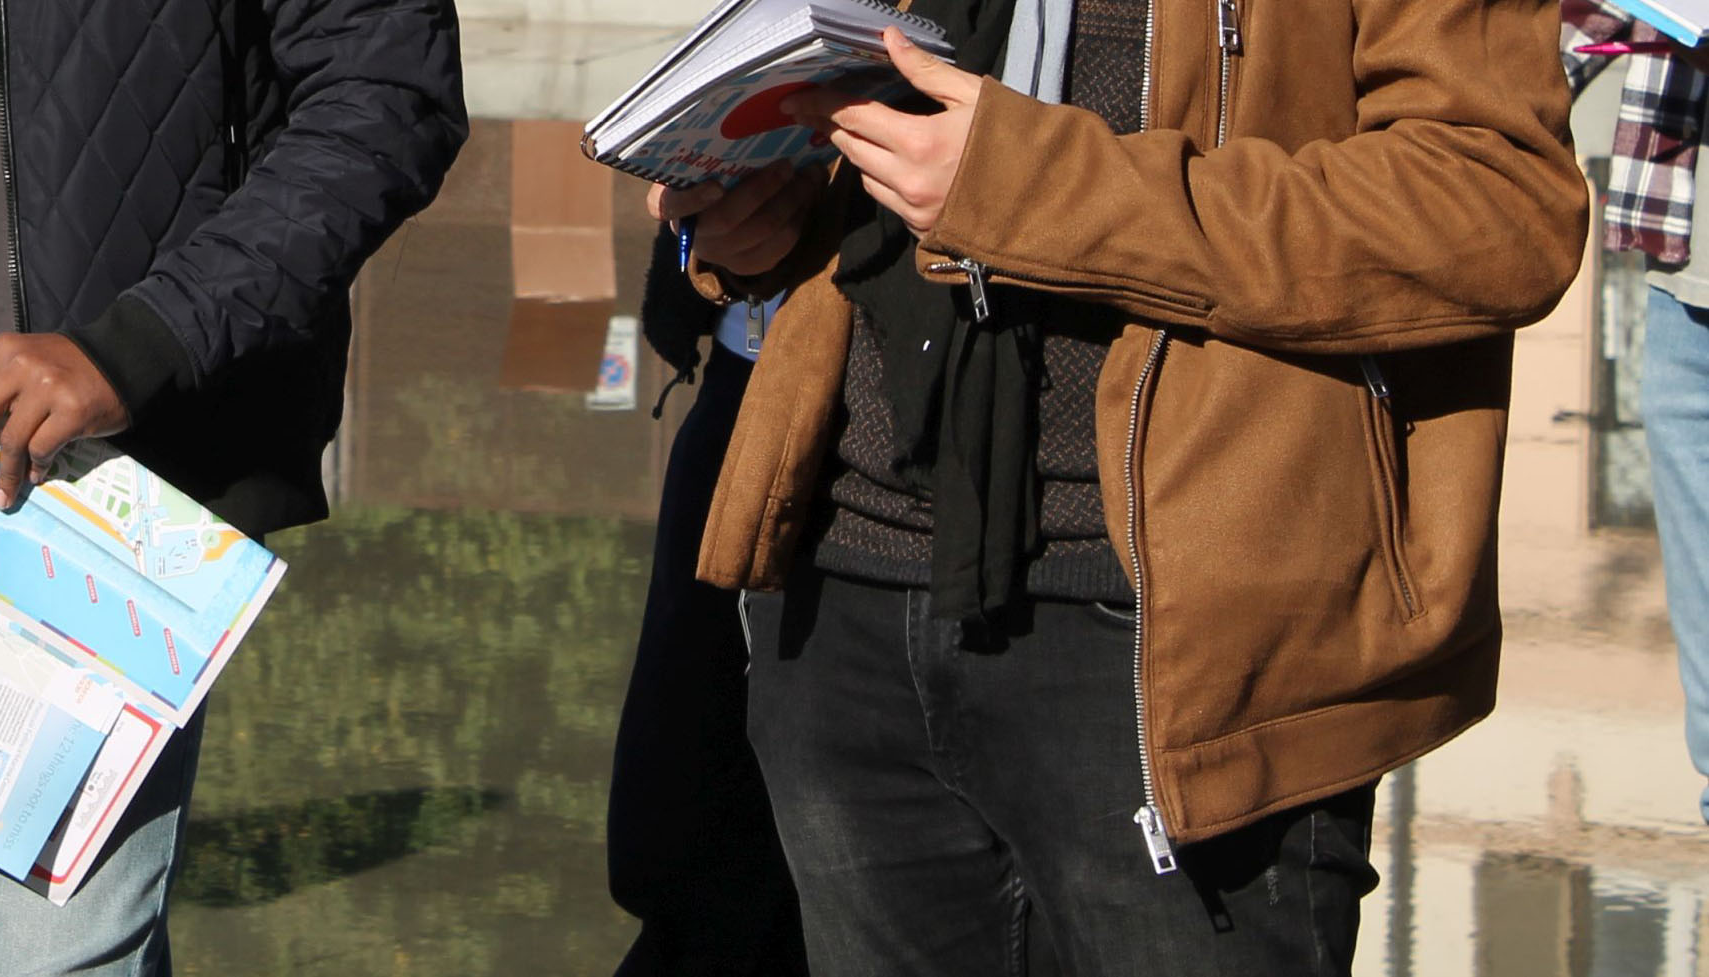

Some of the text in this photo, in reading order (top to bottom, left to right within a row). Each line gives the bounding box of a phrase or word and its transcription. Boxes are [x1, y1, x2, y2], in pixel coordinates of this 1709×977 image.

[58, 734, 75, 753] 12
[38, 752, 65, 789] things
[25, 787, 44, 810] not
[17, 809, 32, 825] to
[3, 824, 22, 851] miss
